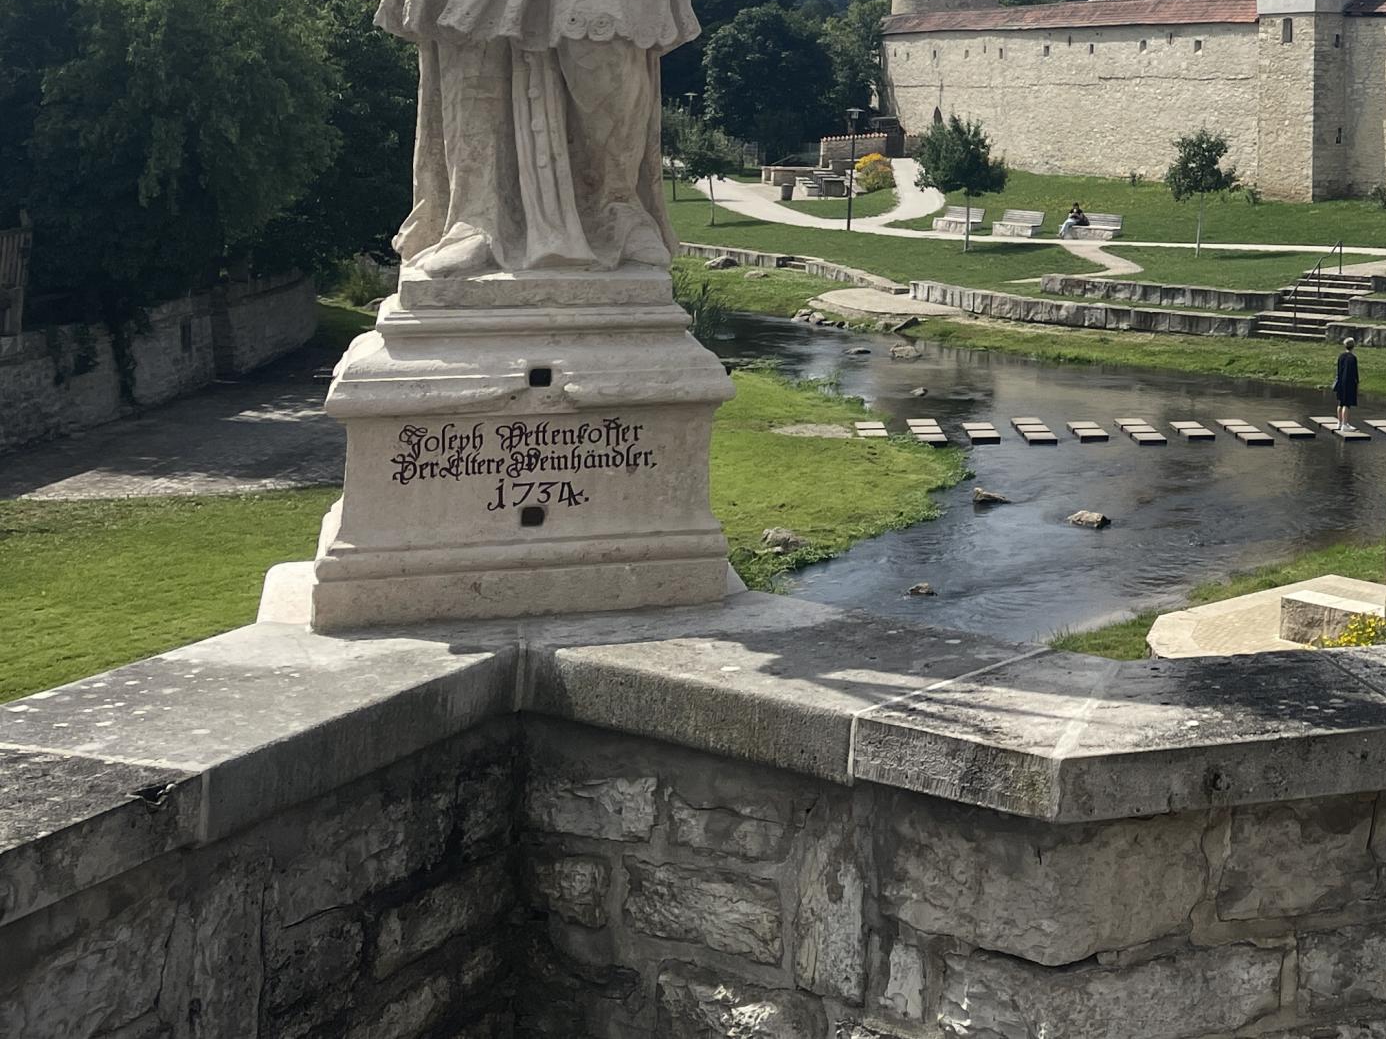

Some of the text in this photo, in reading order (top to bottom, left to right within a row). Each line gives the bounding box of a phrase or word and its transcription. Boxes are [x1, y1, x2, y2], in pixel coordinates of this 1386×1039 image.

[399, 422, 484, 459] Joseph
[390, 454, 439, 484] Der
[506, 443, 657, 478] Weinhändler,
[487, 479, 590, 511] 1734.
